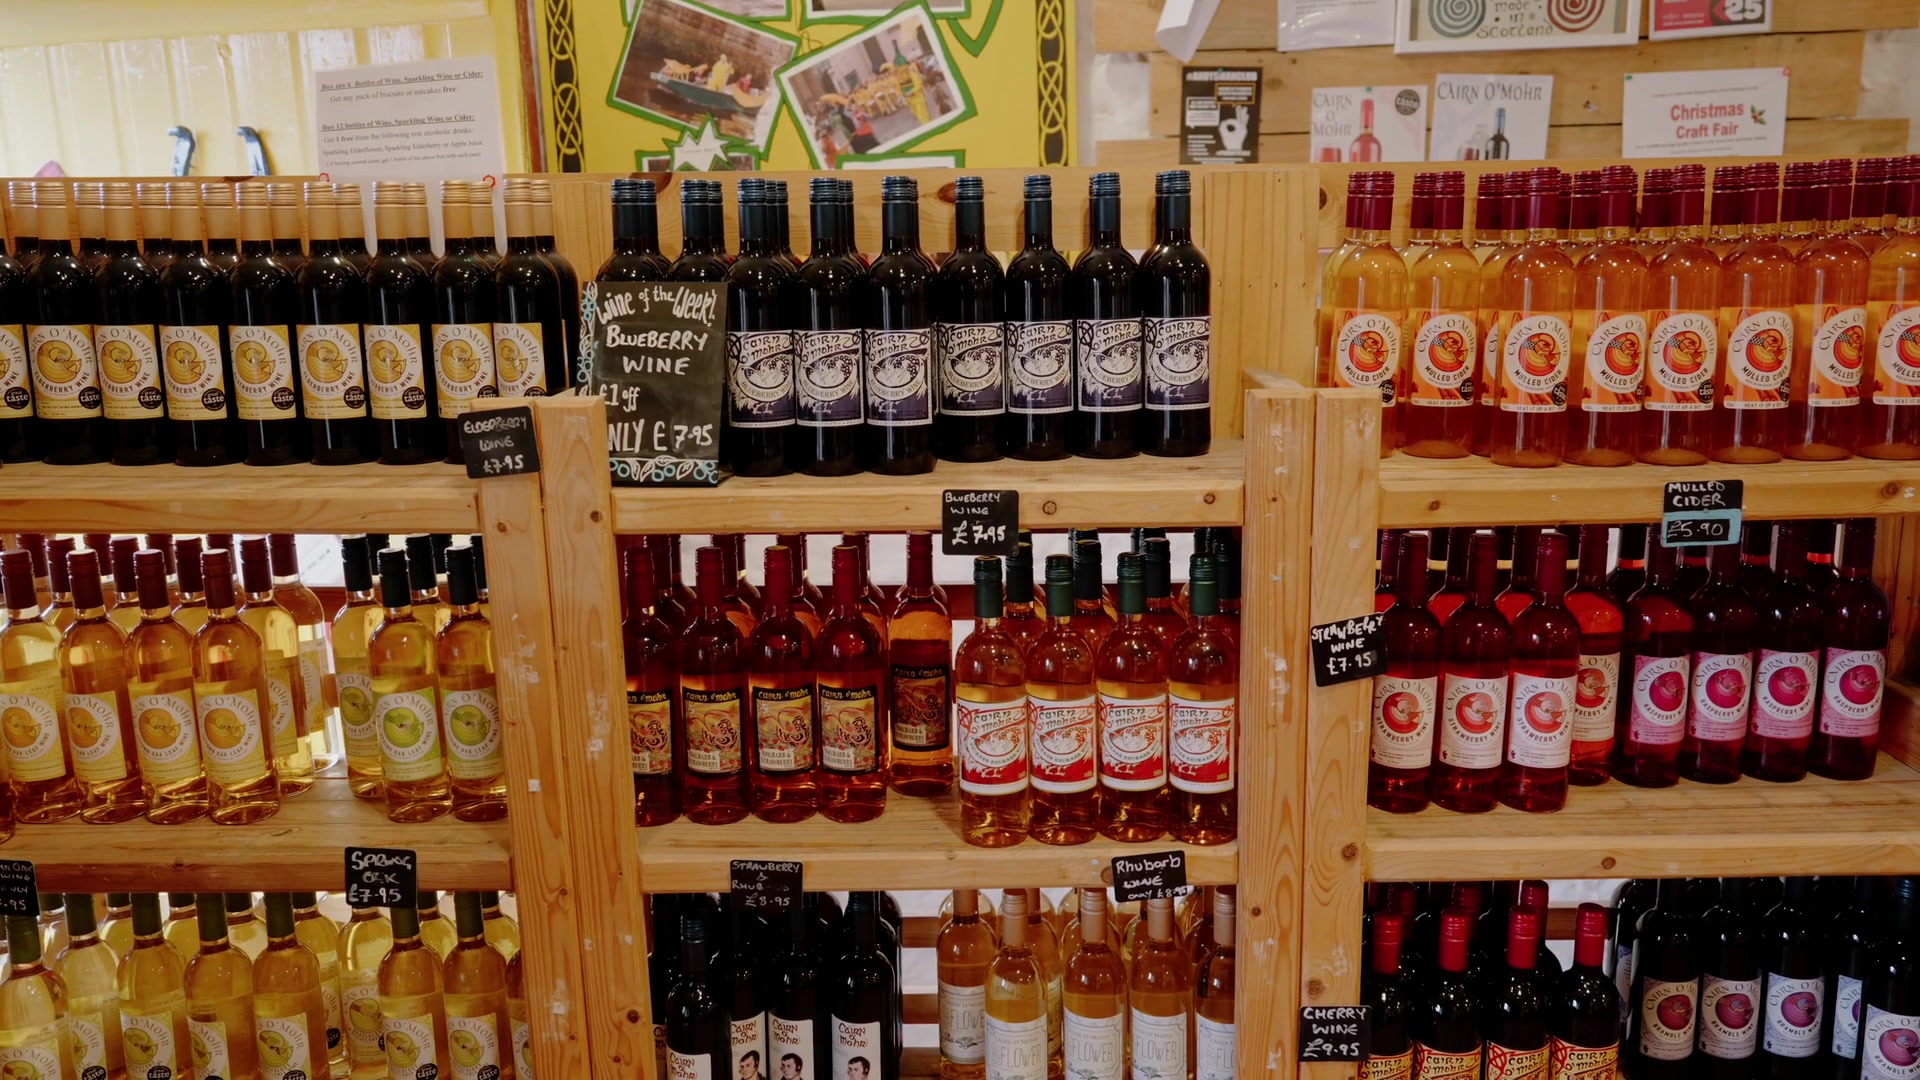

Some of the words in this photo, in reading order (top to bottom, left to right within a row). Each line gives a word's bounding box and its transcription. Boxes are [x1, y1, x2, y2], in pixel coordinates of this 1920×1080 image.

[355, 79, 376, 88] Bottles
[377, 78, 384, 86] of
[404, 74, 435, 84] Sparkling
[436, 73, 453, 81] Wine
[454, 72, 462, 80] or
[330, 95, 342, 103] Get
[343, 94, 354, 103] any
[355, 93, 370, 102] pack
[371, 91, 380, 99] of
[380, 89, 404, 99] biscuits
[414, 88, 441, 96] oatcakes
[442, 86, 457, 94] free
[1313, 92, 1352, 111] CAIRN
[1437, 82, 1480, 105] CAIRN
[1484, 82, 1543, 101] O'MOHR
[1670, 102, 1745, 121] Christmas
[337, 123, 344, 131] 12
[345, 121, 366, 130] bottles
[367, 120, 374, 128] of
[394, 116, 426, 126] Sparkling
[426, 116, 444, 124] Wine
[1312, 122, 1352, 137] MOHR
[1676, 123, 1708, 139] Craft
[1713, 121, 1739, 137] Fair
[323, 136, 335, 144] Get
[341, 135, 353, 143] free
[355, 134, 370, 142] from
[381, 131, 410, 140] following
[424, 128, 451, 137] alcoholic
[323, 149, 349, 157] Sparkling
[385, 144, 412, 153] Sparkling
[412, 142, 441, 151] Elderberry
[450, 140, 468, 149] Apple
[638, 288, 650, 313] of
[652, 286, 676, 302] the
[49, 328, 92, 364] O'MOHR
[318, 327, 358, 364] O'MOHR
[605, 324, 709, 351] BLUEBERRY
[245, 329, 287, 365] O'MOHR
[622, 355, 691, 376] WINE
[1345, 365, 1370, 382] MULLED
[1372, 366, 1391, 382] CIDER
[75, 371, 90, 388] WINE
[268, 373, 284, 388] WINE
[1514, 369, 1541, 386] MULLED
[1544, 370, 1563, 385] CIDER
[1659, 368, 1687, 385] MULLED
[1690, 367, 1709, 384] CIDER
[80, 394, 101, 402] taste
[345, 394, 365, 402] taste
[622, 387, 641, 412] off
[480, 435, 515, 452] WINE
[608, 419, 645, 453] NLY
[1668, 481, 1725, 493] MULLED
[945, 492, 1000, 503] BLUEBERRY
[1672, 492, 1726, 507] CIDER
[950, 506, 989, 515] WINE
[1667, 520, 1723, 538] £5.90
[1311, 616, 1383, 643] STRAWBERRY
[1330, 638, 1365, 653] WINE
[215, 696, 257, 727] O'MOHR
[394, 695, 434, 725] O'MOHR
[1762, 696, 1799, 714] RASPBERRY
[1800, 699, 1812, 711] WINE
[1376, 717, 1414, 742] STRAWBERRY
[1416, 722, 1428, 737] WINE
[732, 861, 800, 873] STRAWBERRY
[1116, 854, 1181, 874] Rhubarb
[1122, 875, 1163, 889] WINE
[745, 892, 790, 907] £8.95
[1303, 1007, 1366, 1020] CHERRY
[393, 1021, 430, 1050] O'MOHR
[1312, 1023, 1358, 1036] WINE
[1652, 1023, 1681, 1038] BRAMBLE
[1072, 1039, 1113, 1063] FLOWER
[1302, 1038, 1360, 1058] £9.95
[417, 1068, 437, 1078] taste
